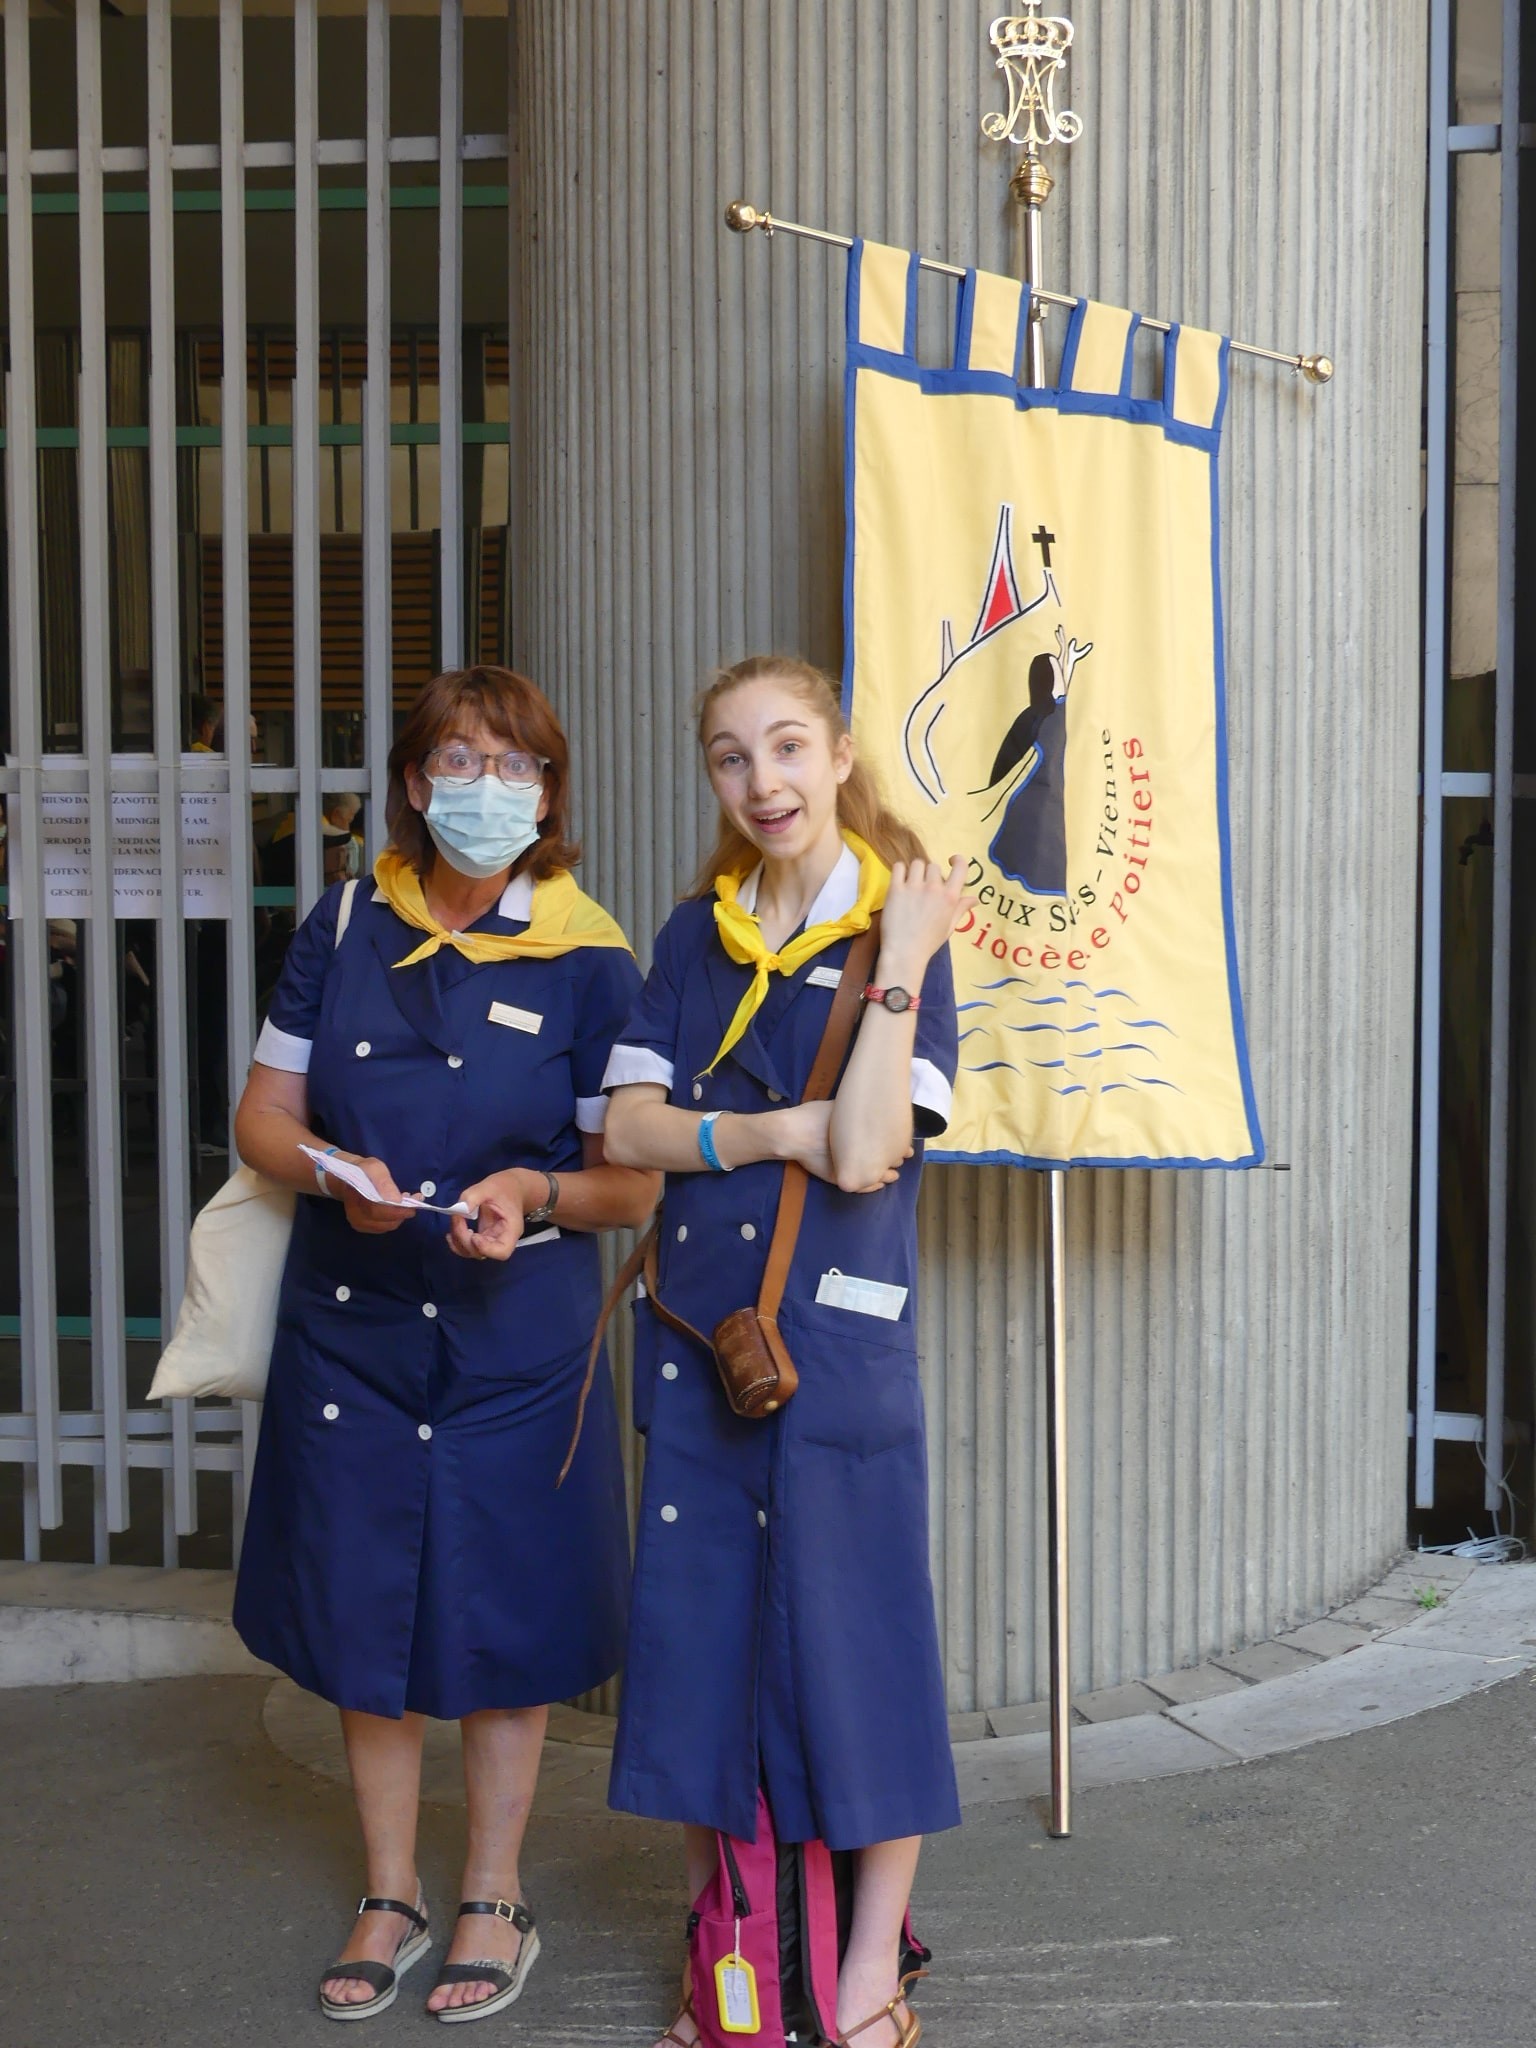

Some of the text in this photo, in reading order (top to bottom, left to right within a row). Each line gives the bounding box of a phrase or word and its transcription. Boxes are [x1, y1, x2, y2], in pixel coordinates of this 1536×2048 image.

[1096, 728, 1118, 857] Vienne
[42, 796, 73, 804] HIUSO
[112, 796, 159, 804] ZANOTTE
[42, 817, 82, 825] CLOSED
[115, 817, 160, 825] MIDNIGH
[1109, 737, 1152, 924] Poitiers
[43, 837, 82, 845] ERRADO
[187, 837, 219, 845] HASTA
[124, 888, 144, 897] VON
